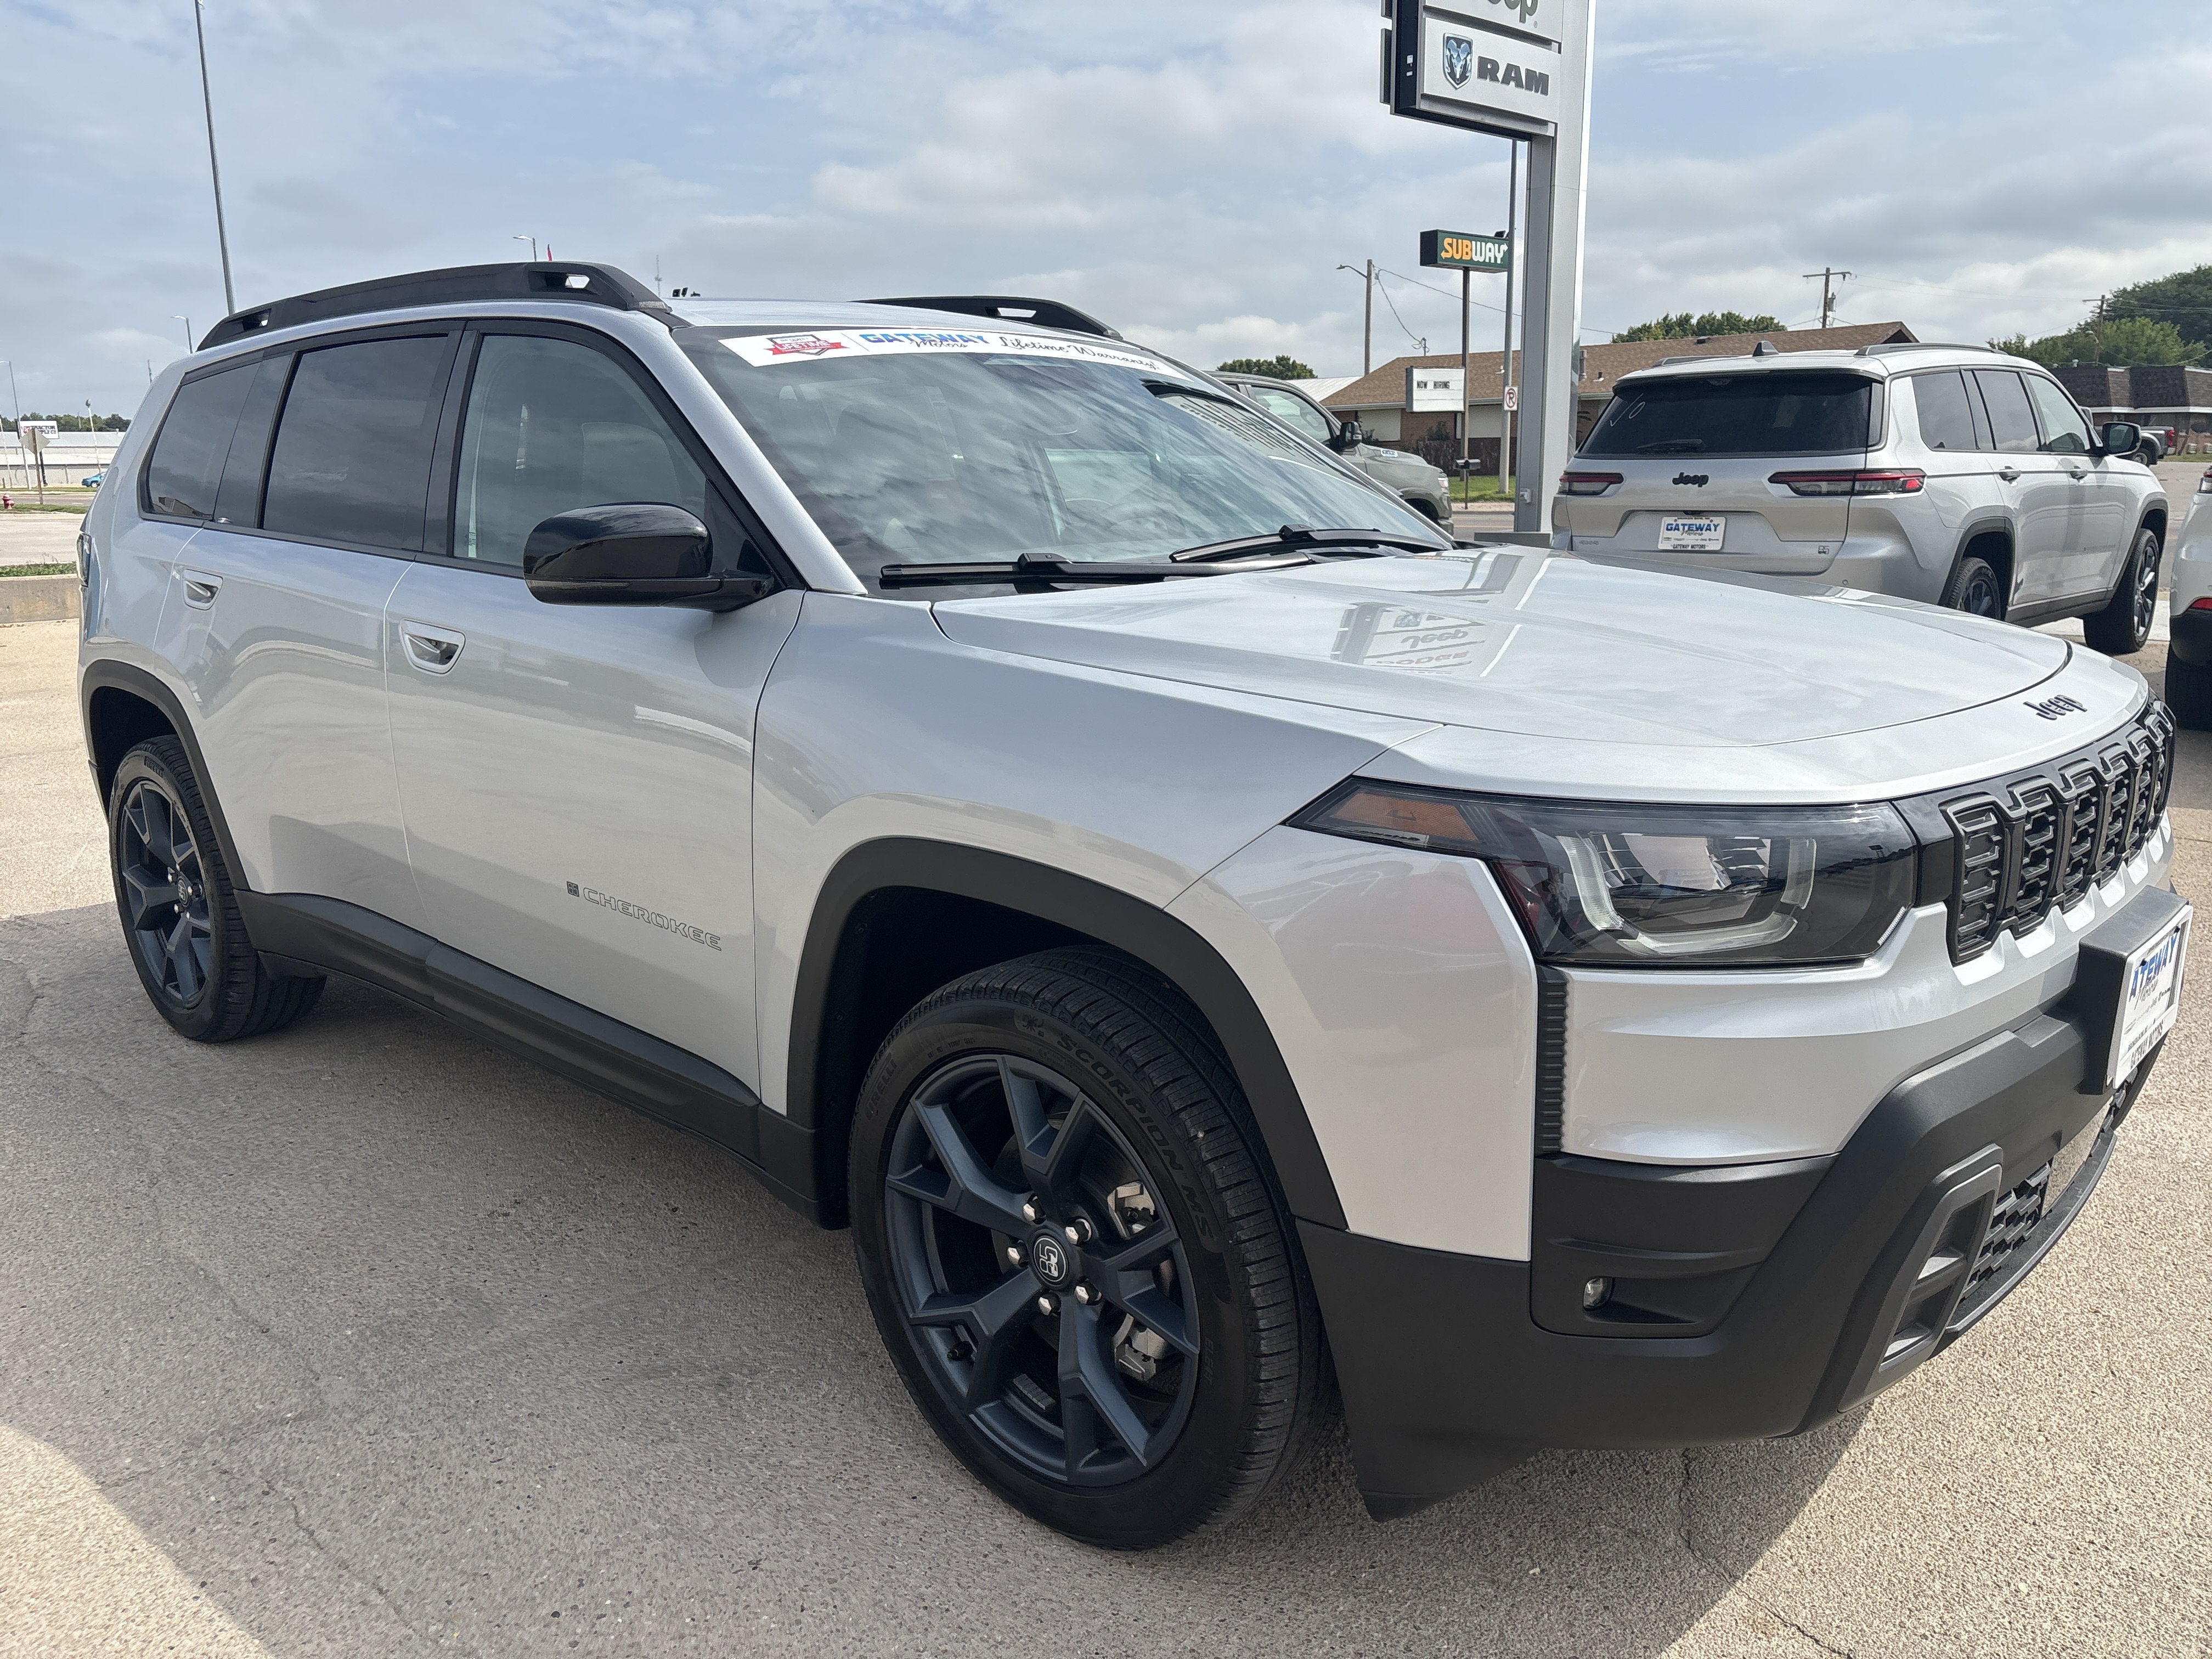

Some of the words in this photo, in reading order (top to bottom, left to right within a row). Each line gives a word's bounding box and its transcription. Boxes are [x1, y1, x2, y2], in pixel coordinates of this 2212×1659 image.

[1477, 56, 1549, 96] RAM
[1441, 238, 1509, 264] SUBWAY
[775, 340, 831, 350] LIFETIME
[859, 334, 990, 343] GATEWAY
[999, 336, 1069, 353] Lifetime
[1672, 472, 1709, 488] Jeep
[1666, 523, 1720, 532] GATEWAY
[2023, 694, 2088, 721] Jeep
[583, 887, 722, 951] CHEROKEE
[2129, 932, 2179, 1003] ATEWAY
[1057, 1031, 1184, 1171] SCORPION
